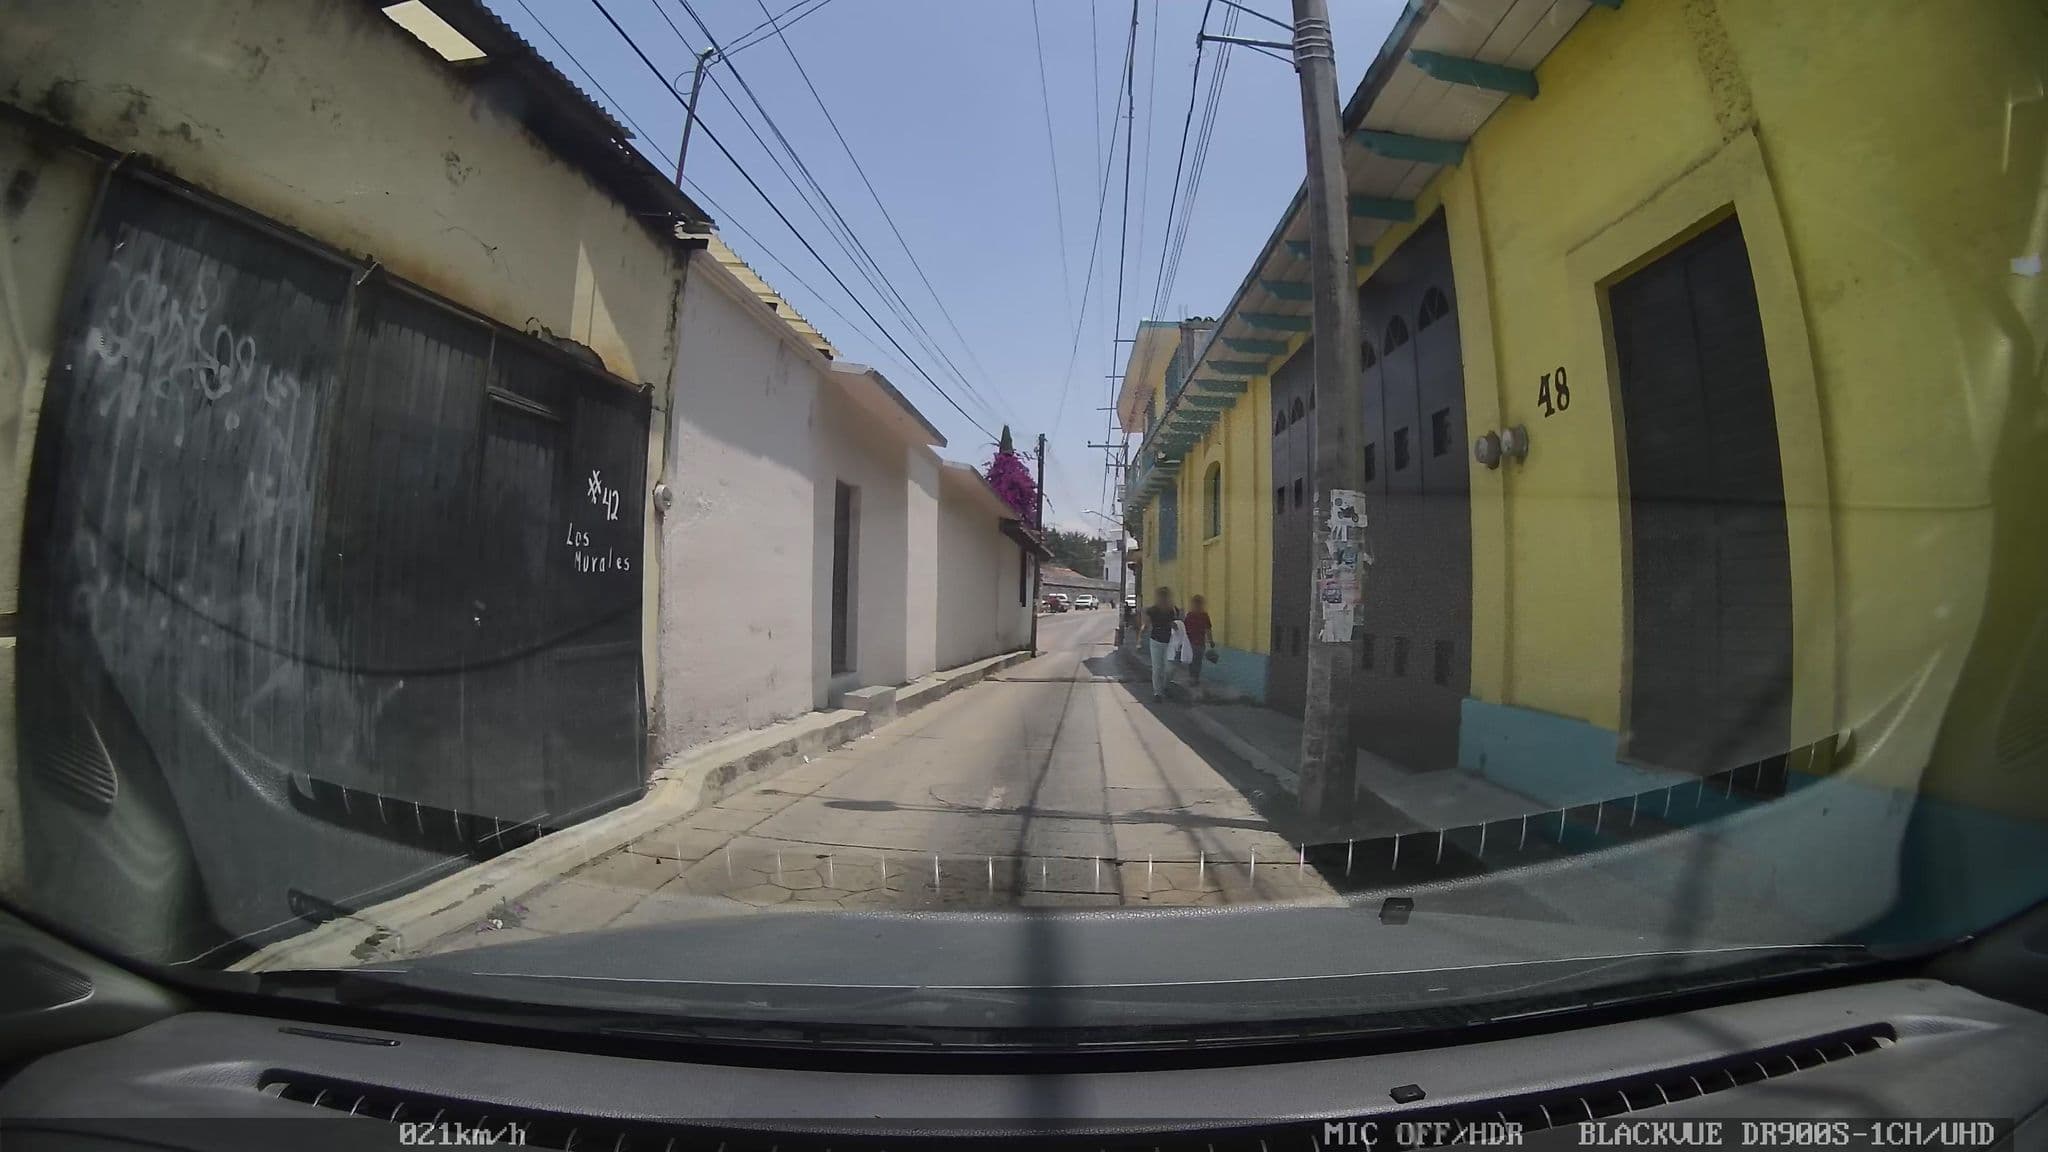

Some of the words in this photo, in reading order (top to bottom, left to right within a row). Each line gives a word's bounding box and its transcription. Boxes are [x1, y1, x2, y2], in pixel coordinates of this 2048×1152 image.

[1538, 366, 1570, 418] 48
[566, 522, 590, 547] Los
[574, 545, 630, 573] Murales
